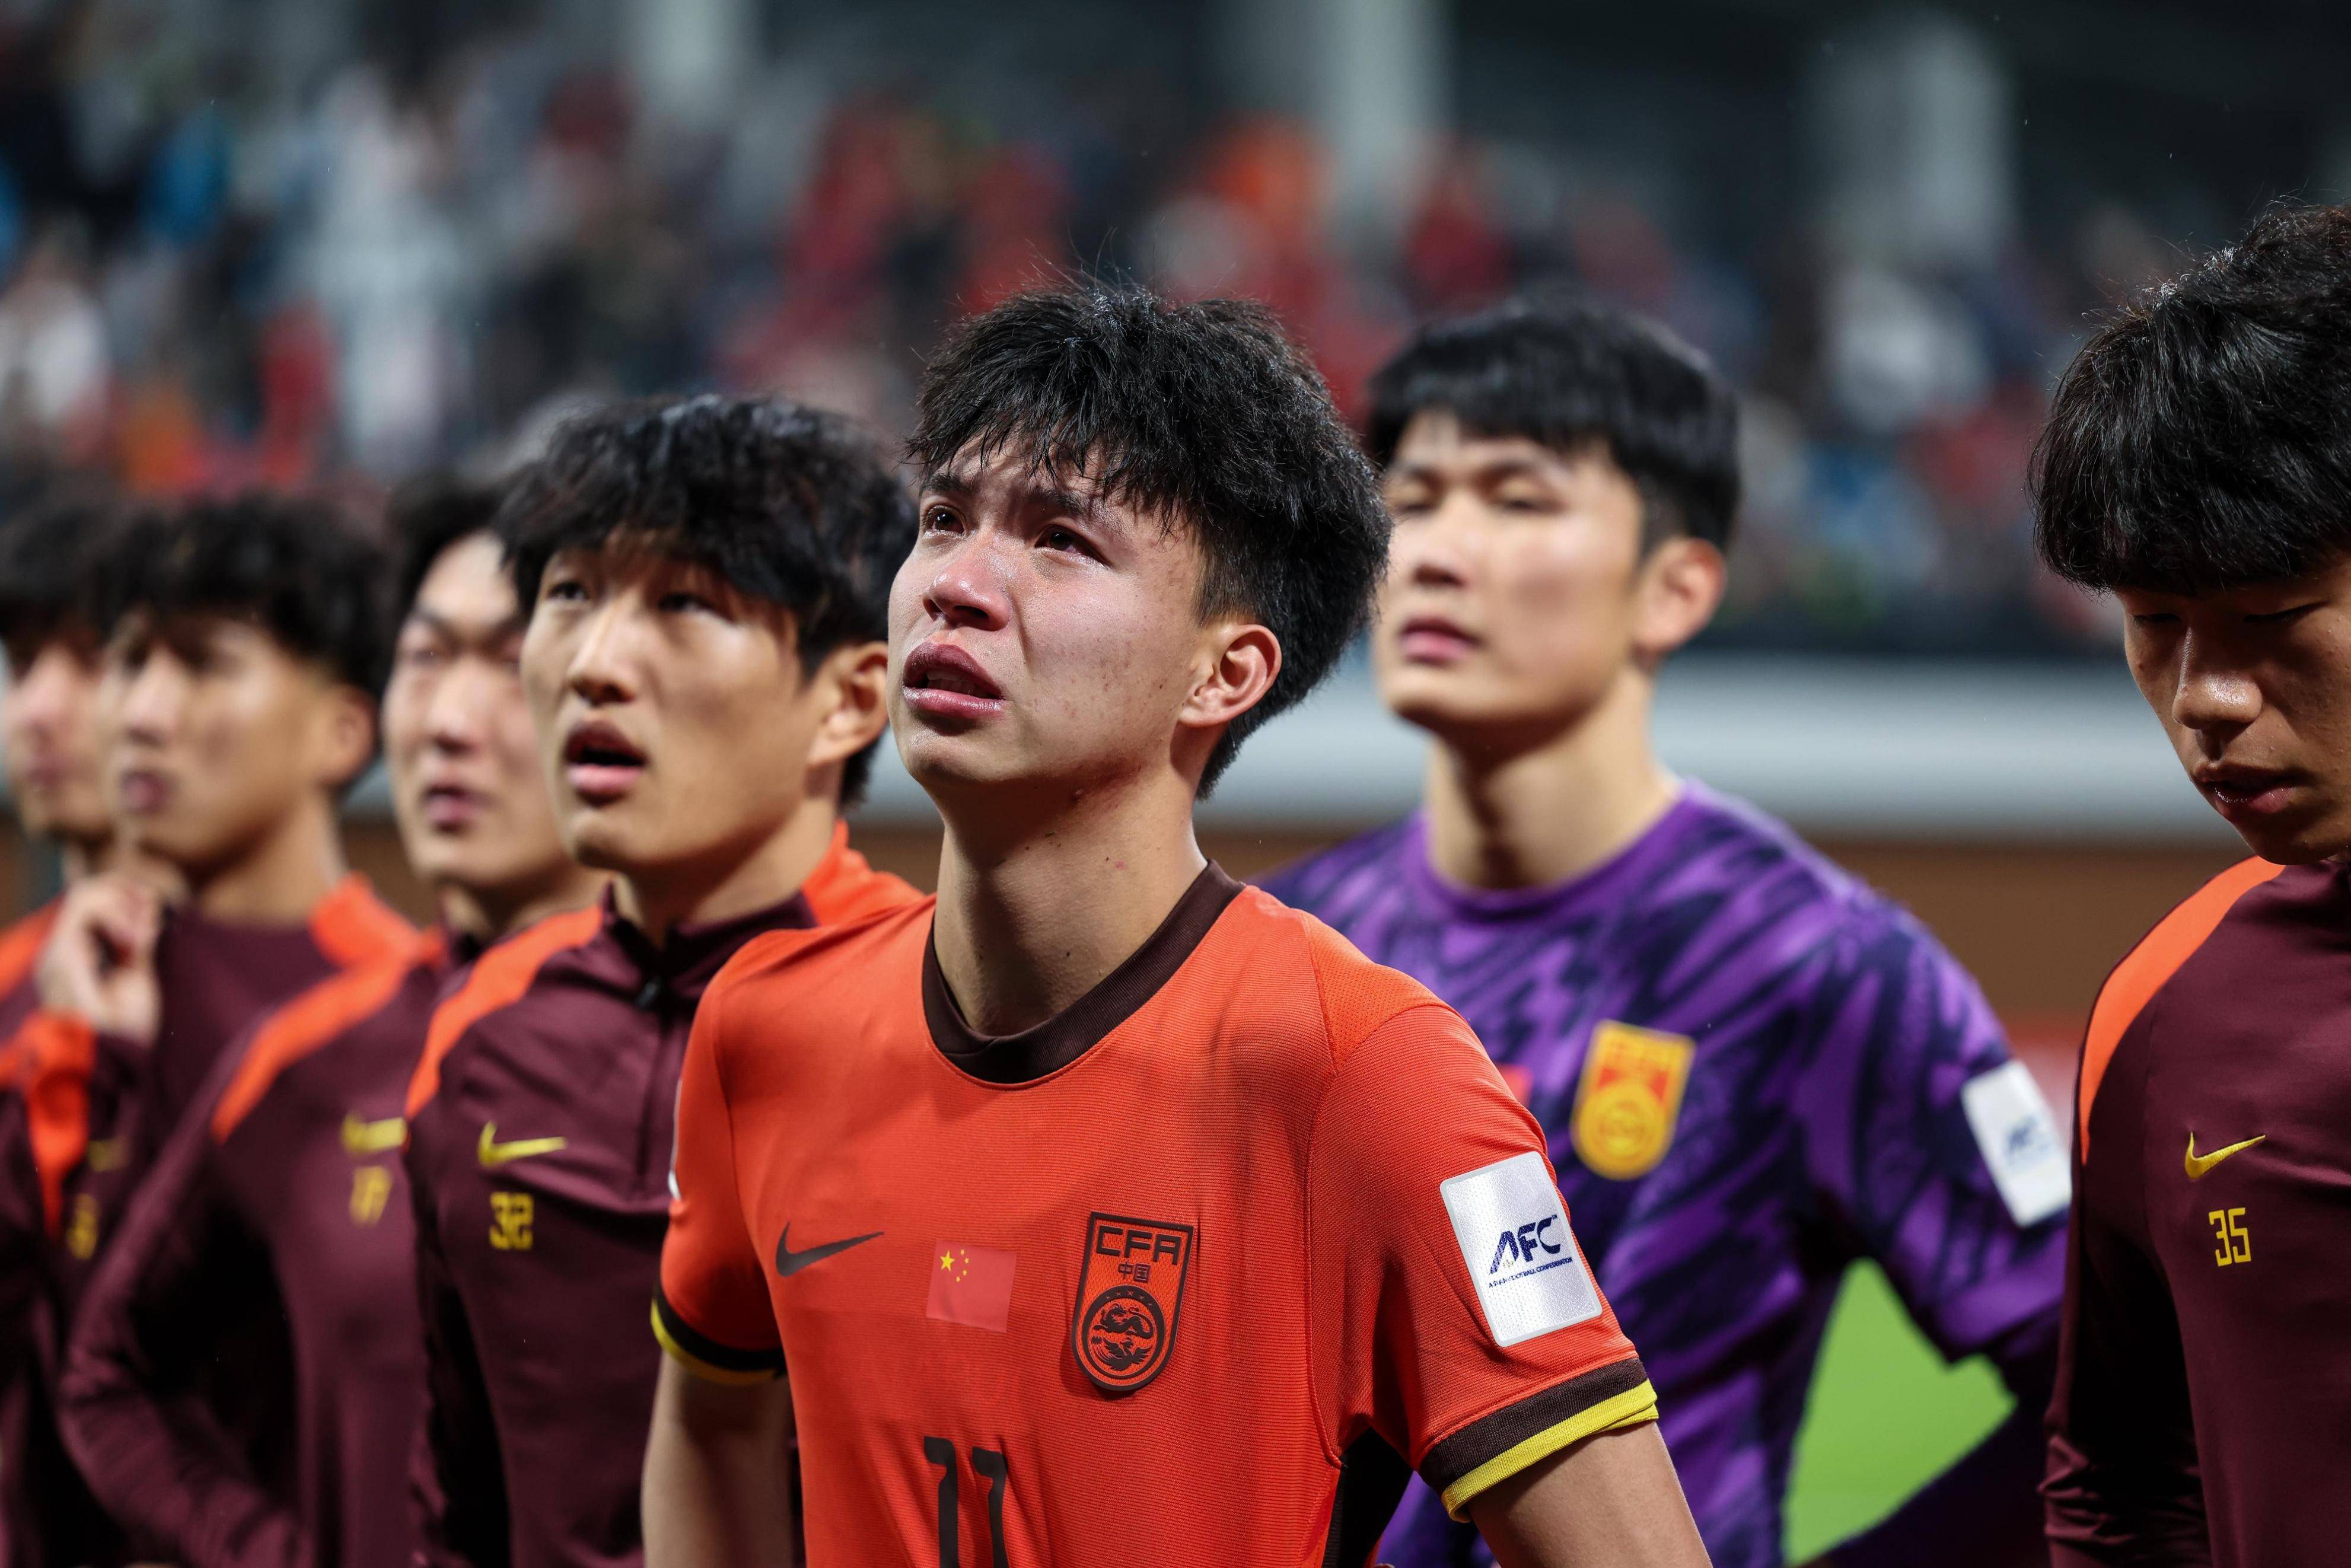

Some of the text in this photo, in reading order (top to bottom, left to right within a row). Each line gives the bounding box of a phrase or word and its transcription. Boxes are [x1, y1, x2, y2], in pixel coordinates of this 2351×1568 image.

[490, 1192, 533, 1249] 32
[1096, 1225, 1182, 1266] CFA
[1489, 1216, 1561, 1274] AFC
[2208, 1207, 2252, 1267] 35
[1118, 1261, 1151, 1283] 中国
[923, 1436, 1010, 1568] 11
